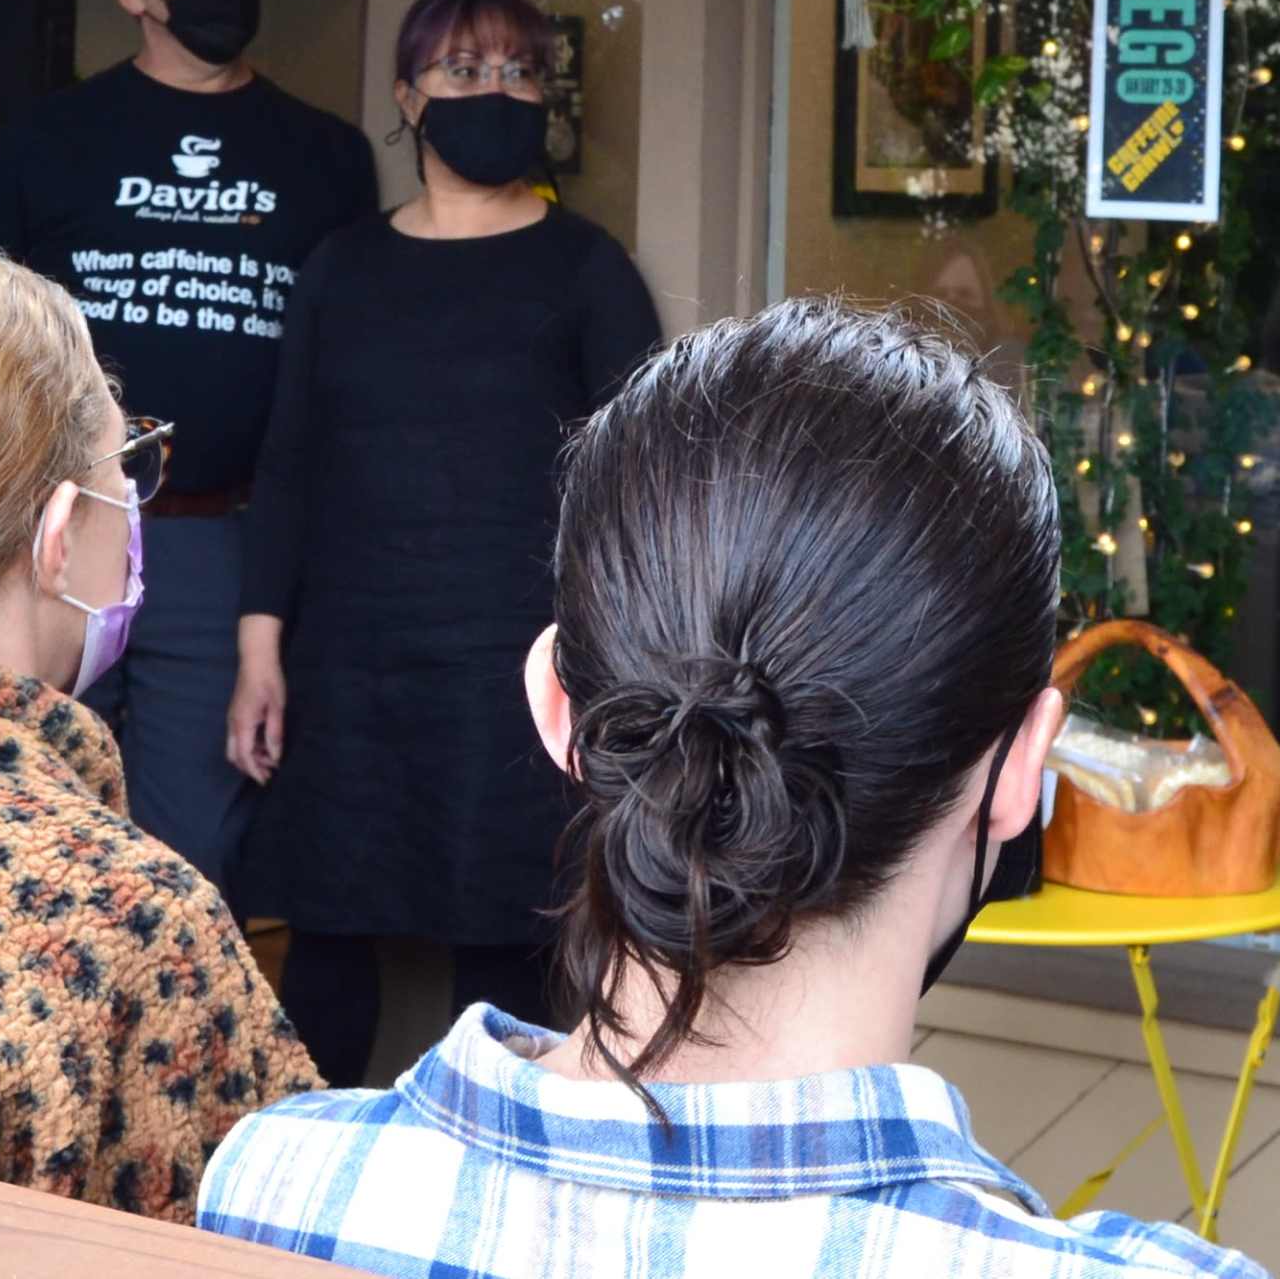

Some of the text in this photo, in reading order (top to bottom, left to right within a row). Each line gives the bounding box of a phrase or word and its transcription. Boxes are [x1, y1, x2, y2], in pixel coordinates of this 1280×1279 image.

[115, 176, 276, 212] David's
[72, 250, 134, 272] When
[140, 248, 233, 275] caffeine
[240, 253, 258, 277] is
[142, 274, 170, 296] of
[175, 279, 258, 309] choice,
[75, 299, 118, 321] ood
[123, 301, 149, 323] to
[156, 302, 189, 327] be
[196, 307, 235, 333] the
